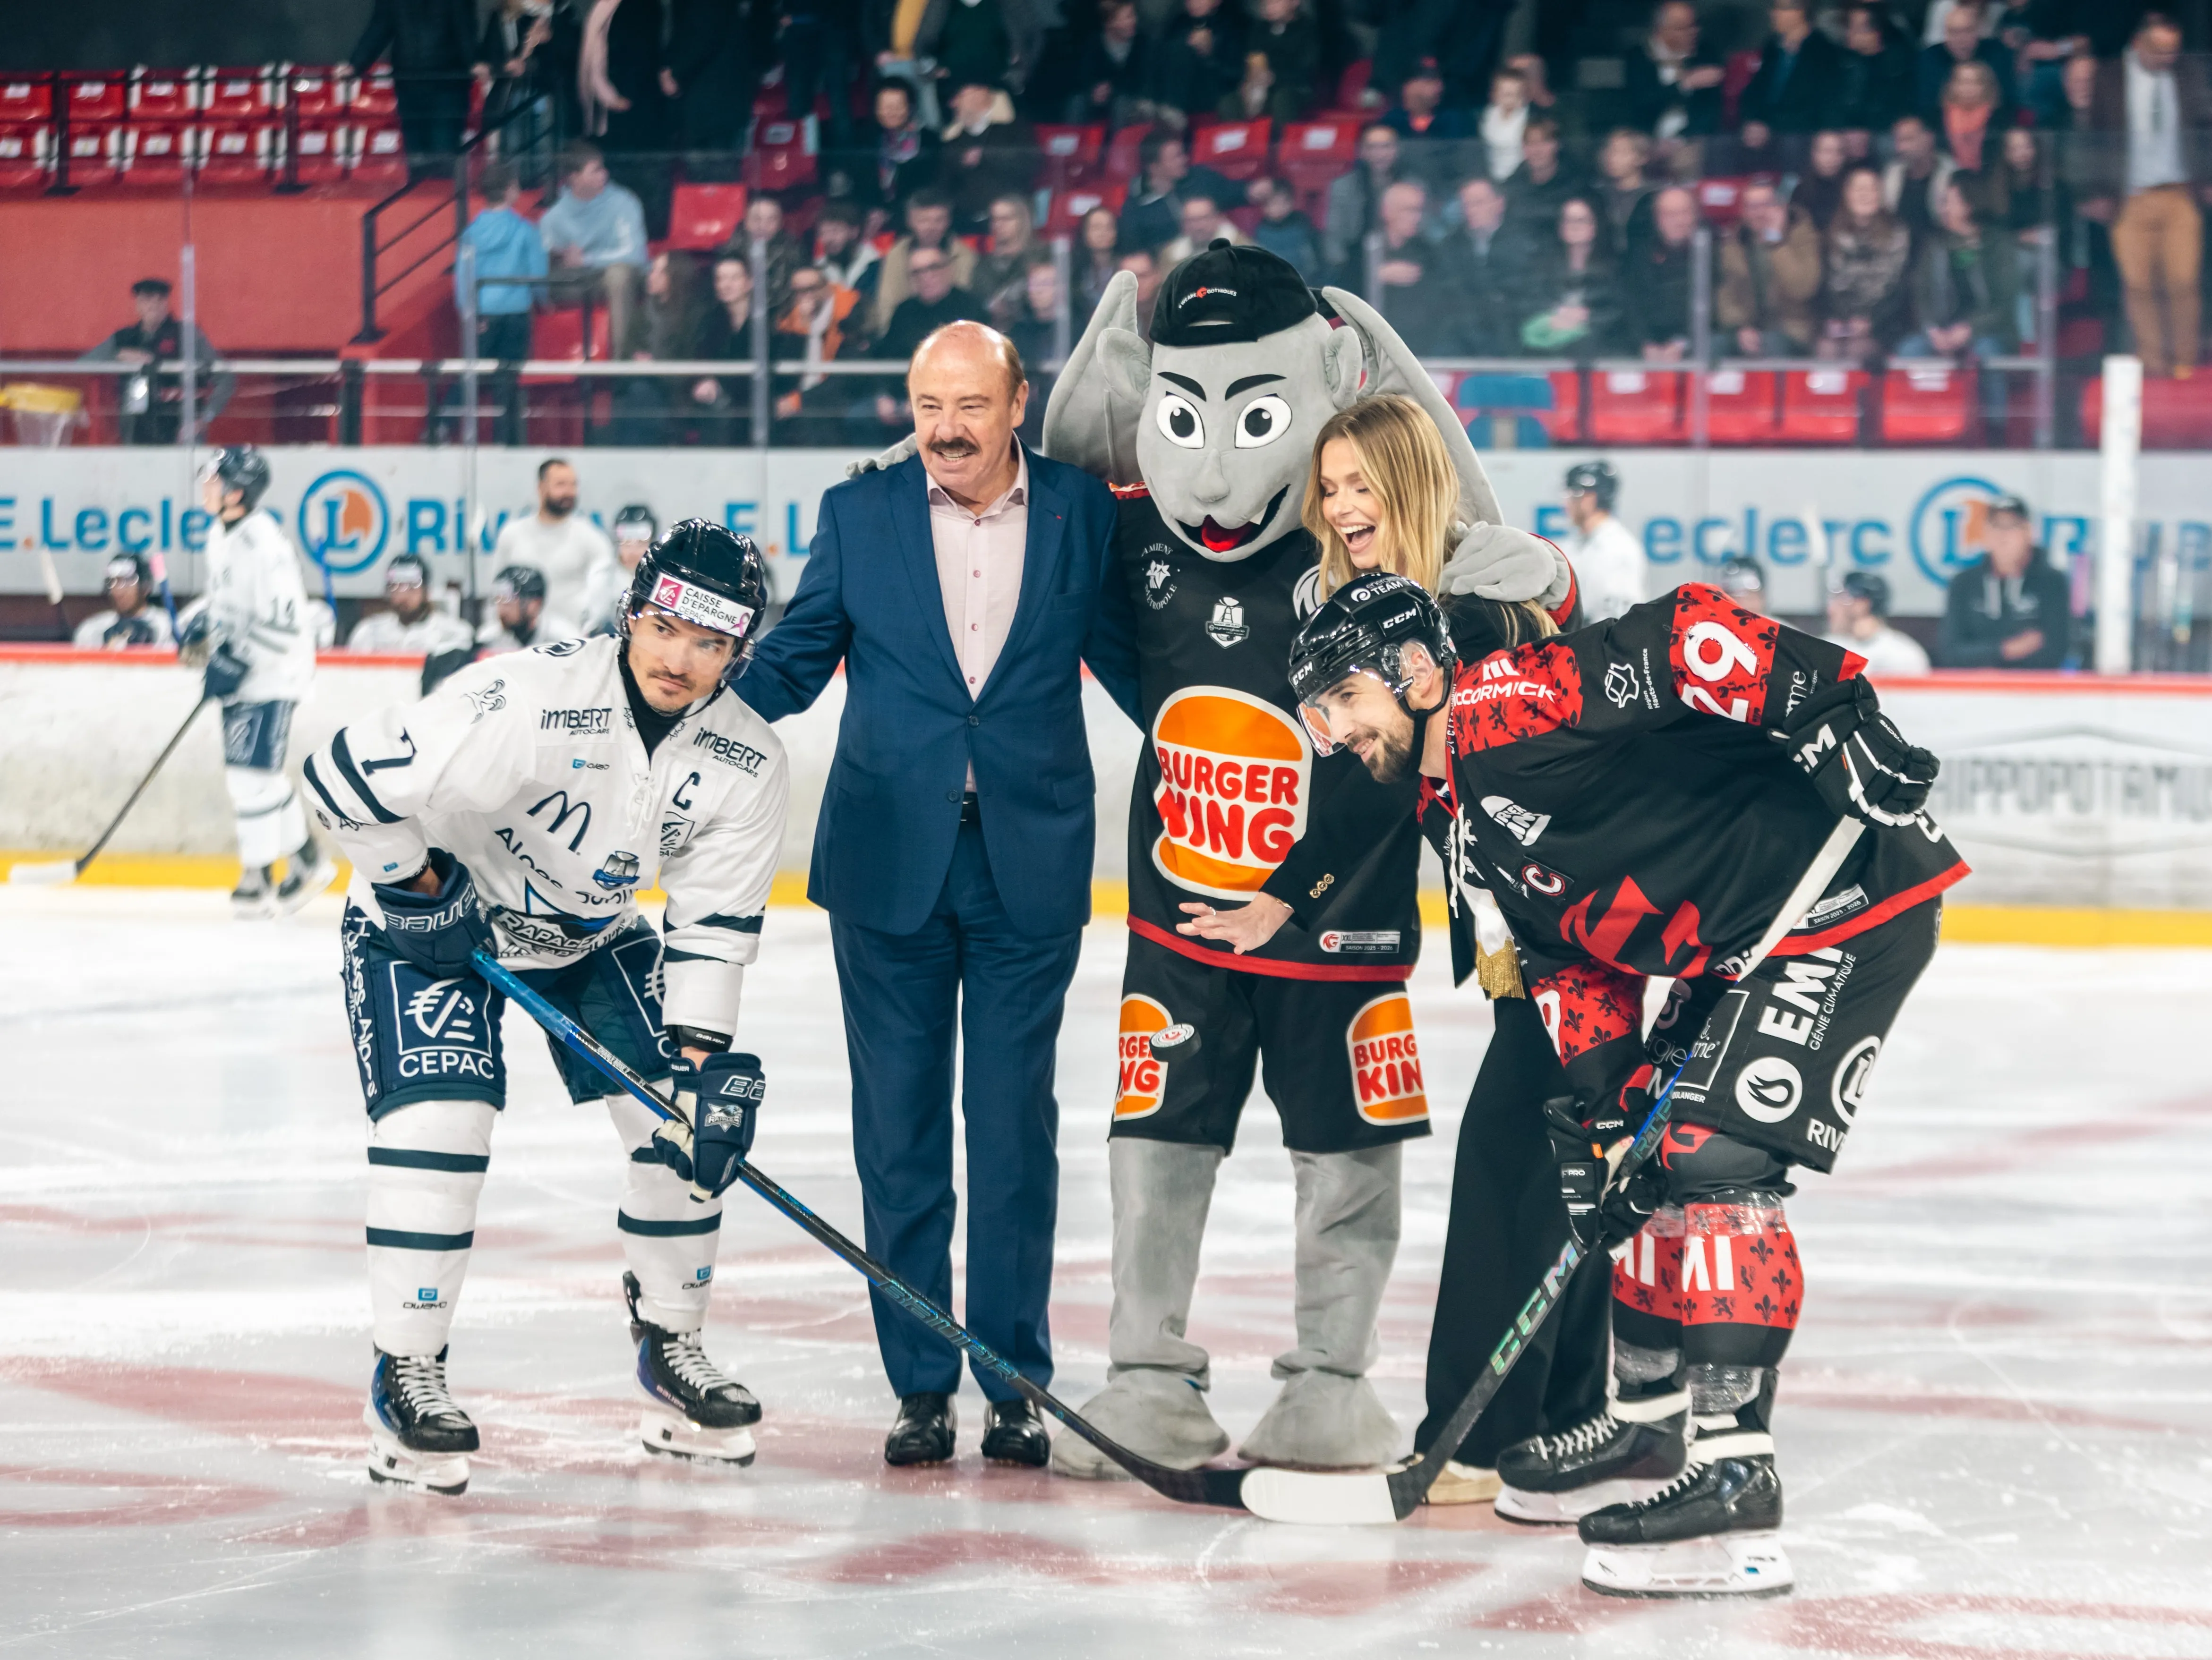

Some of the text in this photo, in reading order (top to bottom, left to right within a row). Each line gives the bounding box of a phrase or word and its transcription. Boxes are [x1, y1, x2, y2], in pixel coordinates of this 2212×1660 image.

[1141, 543, 1173, 557] AMIENS
[685, 587, 723, 608] CAISSE
[1370, 580, 1403, 595] TEAM
[679, 605, 706, 621] CEPAC
[682, 597, 738, 625] D'EPARGNE
[1383, 608, 1417, 629] CCM
[1291, 660, 1314, 686] CCM
[1399, 678, 1414, 689] CCM
[1643, 647, 1661, 709] Hauts-de-France
[712, 755, 759, 778] AUTOCARS
[1156, 746, 1299, 807] BURGER
[672, 771, 702, 811] C
[1522, 864, 1566, 896] C
[1813, 914, 1830, 924] SAISON
[1822, 953, 1857, 1014] CLIMATIQUE
[1809, 1014, 1830, 1051] GÉNIE
[399, 1051, 495, 1079] CEPAC
[1596, 1120, 1624, 1130] CCM
[1489, 1239, 1581, 1376] CCM
